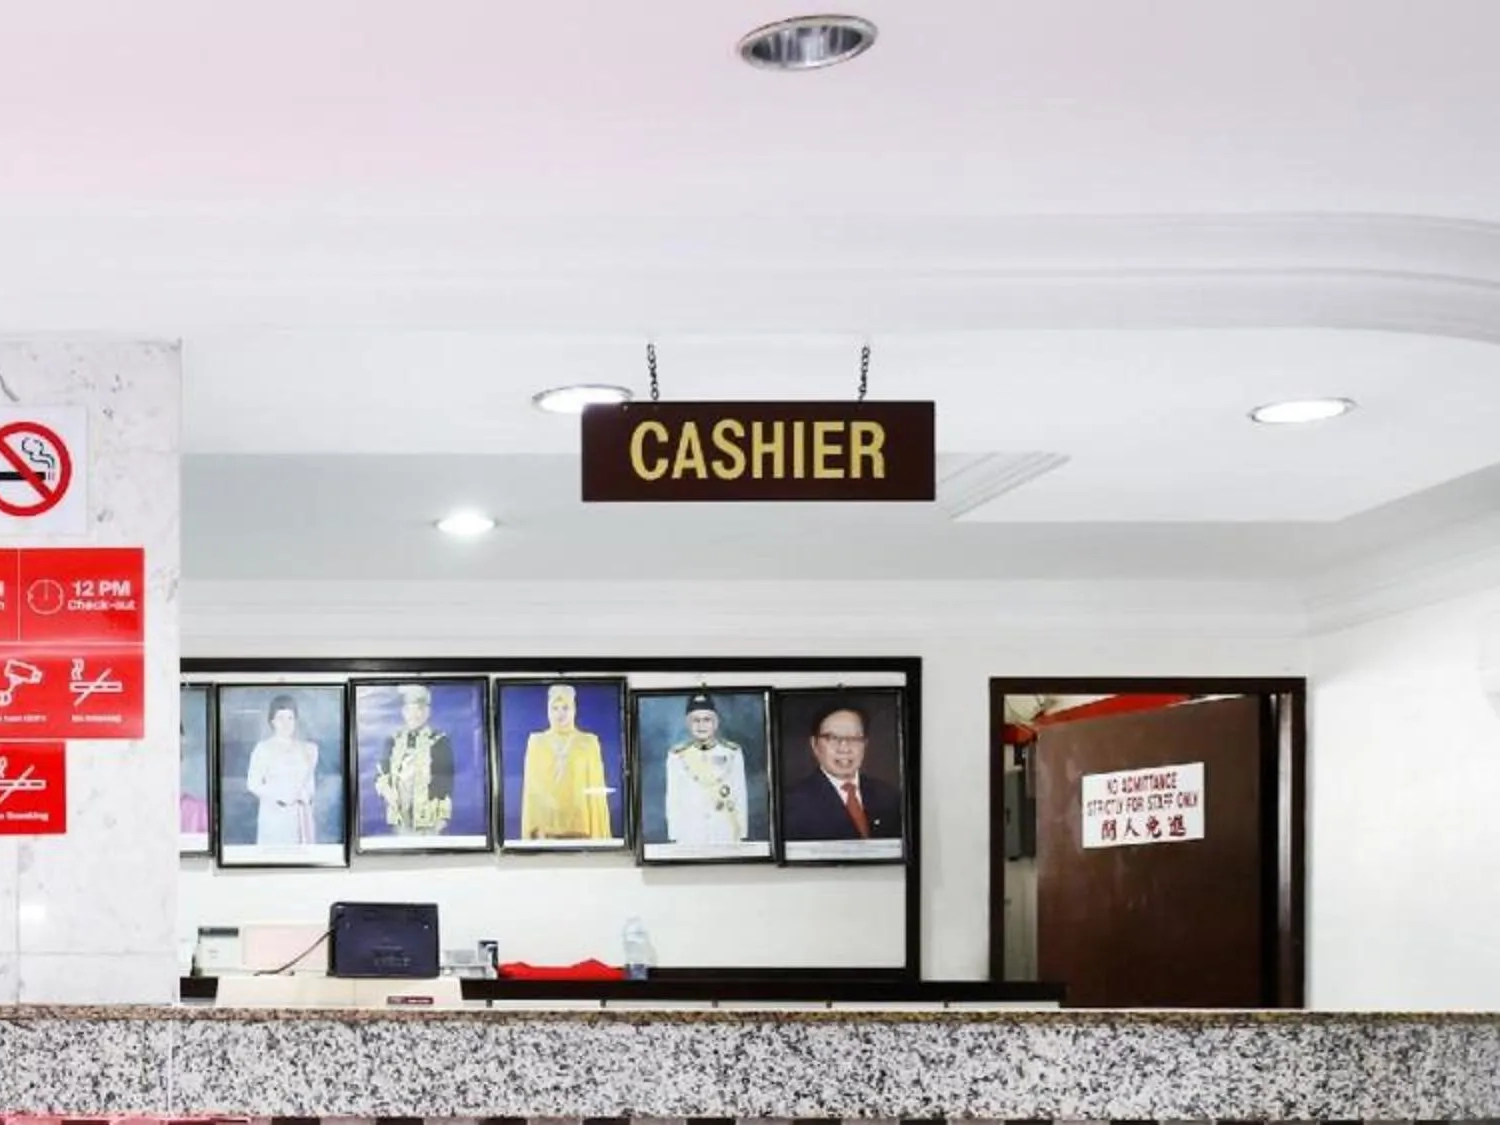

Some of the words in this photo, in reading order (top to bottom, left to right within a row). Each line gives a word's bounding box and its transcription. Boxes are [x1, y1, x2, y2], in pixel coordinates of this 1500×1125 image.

[629, 419, 887, 481] CASHIER
[72, 580, 96, 597] 12
[99, 580, 132, 597] PM
[67, 599, 137, 612] Check-out
[1121, 771, 1178, 794] ADMITTANCE
[1125, 795, 1144, 813] FOR
[1147, 792, 1175, 811] STAFF
[1176, 790, 1198, 809] ONLY
